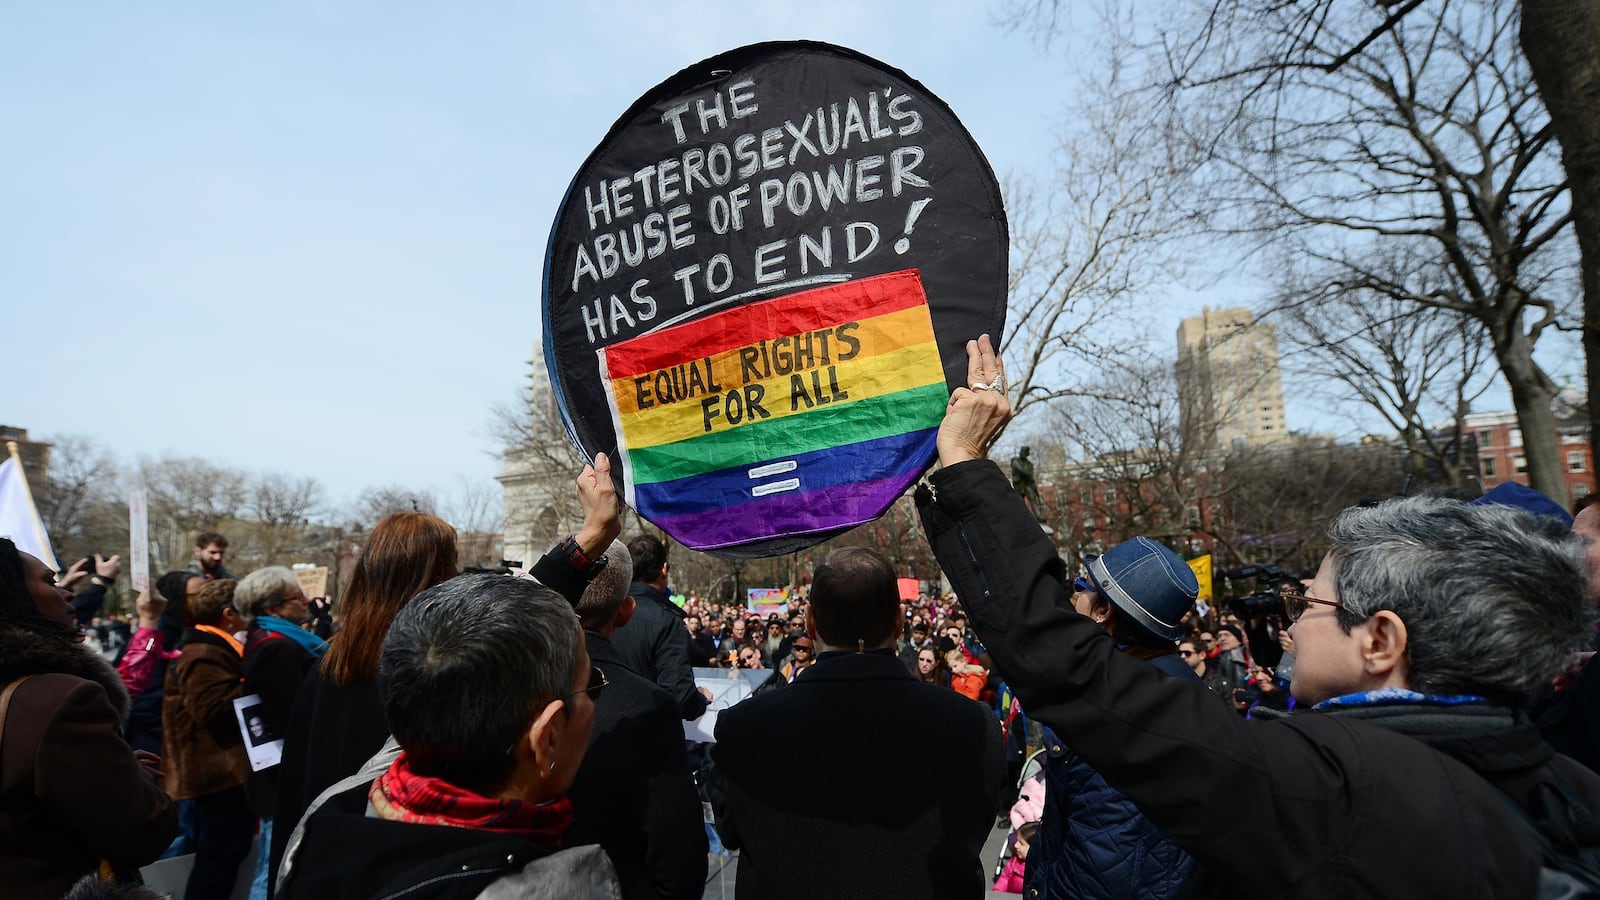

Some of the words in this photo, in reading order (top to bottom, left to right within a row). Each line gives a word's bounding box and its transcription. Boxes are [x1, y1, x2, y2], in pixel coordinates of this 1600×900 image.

[584, 86, 923, 231] HETEROSEXUAL'S
[661, 77, 759, 144] THE
[571, 203, 696, 292] ABUSE
[707, 183, 750, 235] OF
[760, 145, 932, 228] POWER
[580, 278, 657, 344] HAS
[673, 252, 734, 306] TO
[755, 198, 933, 284] END!
[634, 357, 723, 410] EQUAL
[701, 384, 770, 432] FOR
[791, 365, 848, 411] ALL
